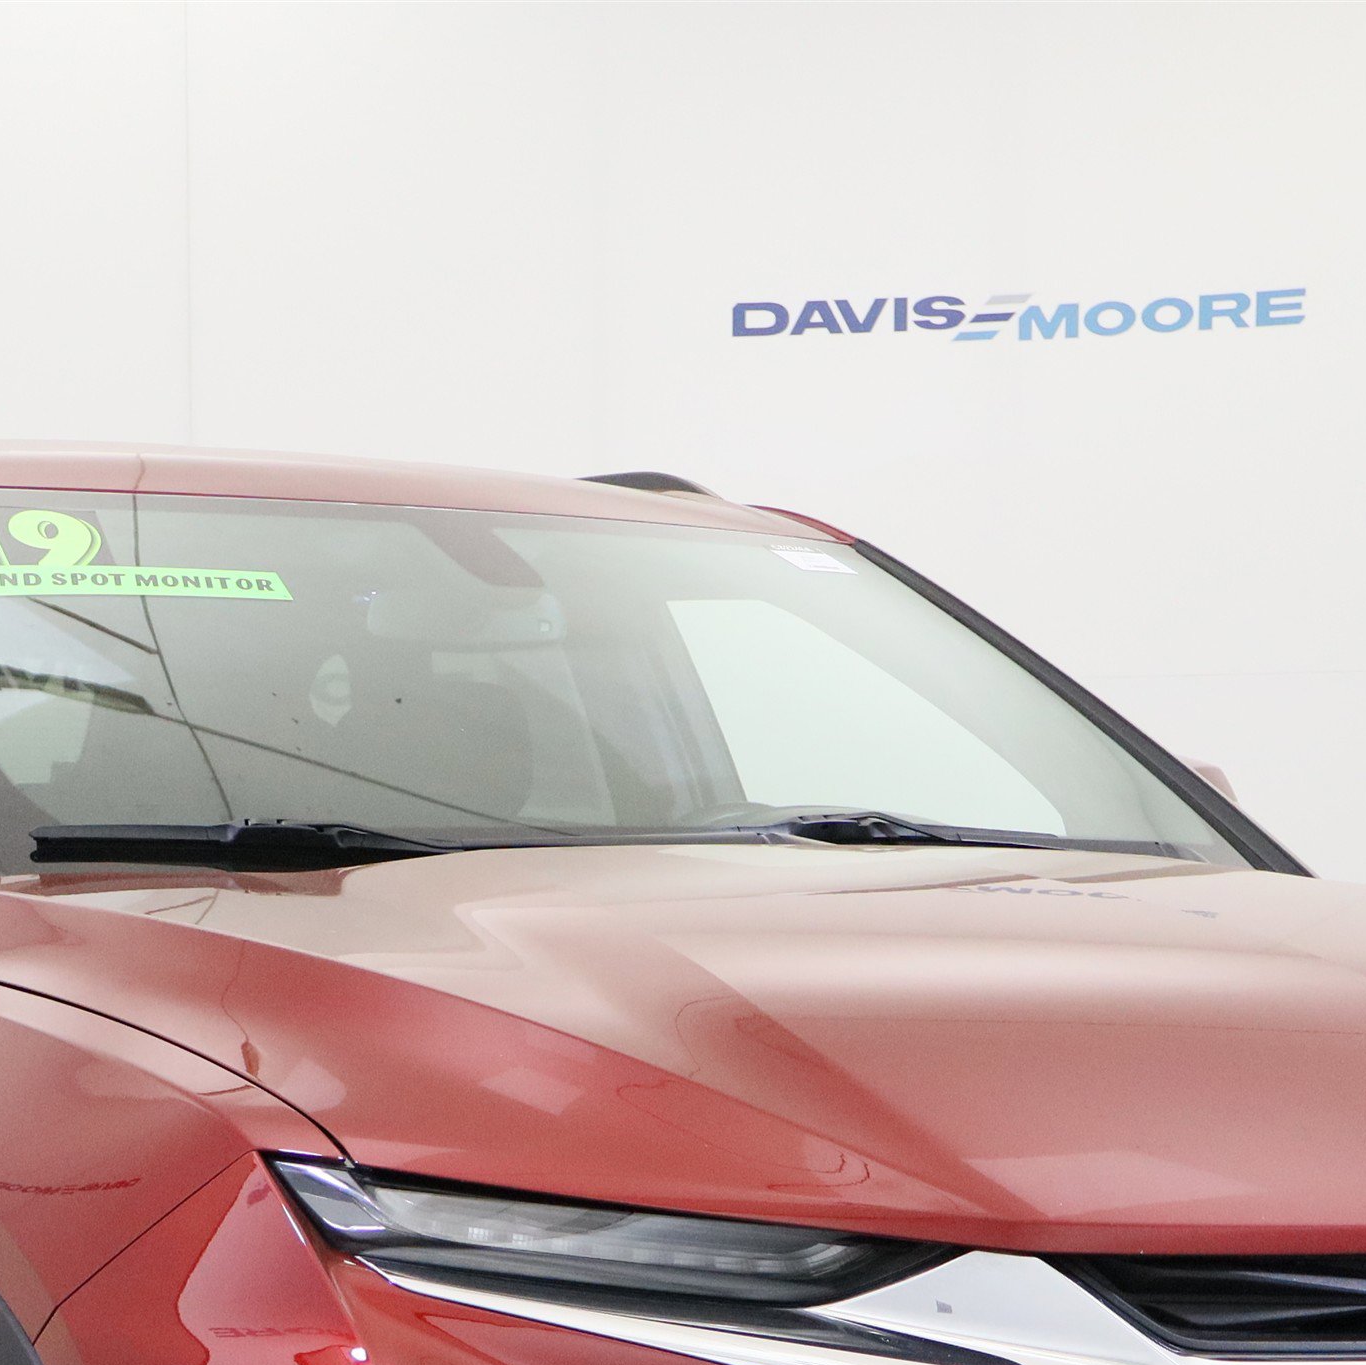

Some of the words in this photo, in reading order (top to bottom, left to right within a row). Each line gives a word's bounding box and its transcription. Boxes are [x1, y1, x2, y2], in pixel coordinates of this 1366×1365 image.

[732, 295, 967, 338] DAVIS
[1017, 288, 1307, 341] MOORE
[50, 571, 126, 587] SPOT
[134, 573, 275, 592] MONITOR
